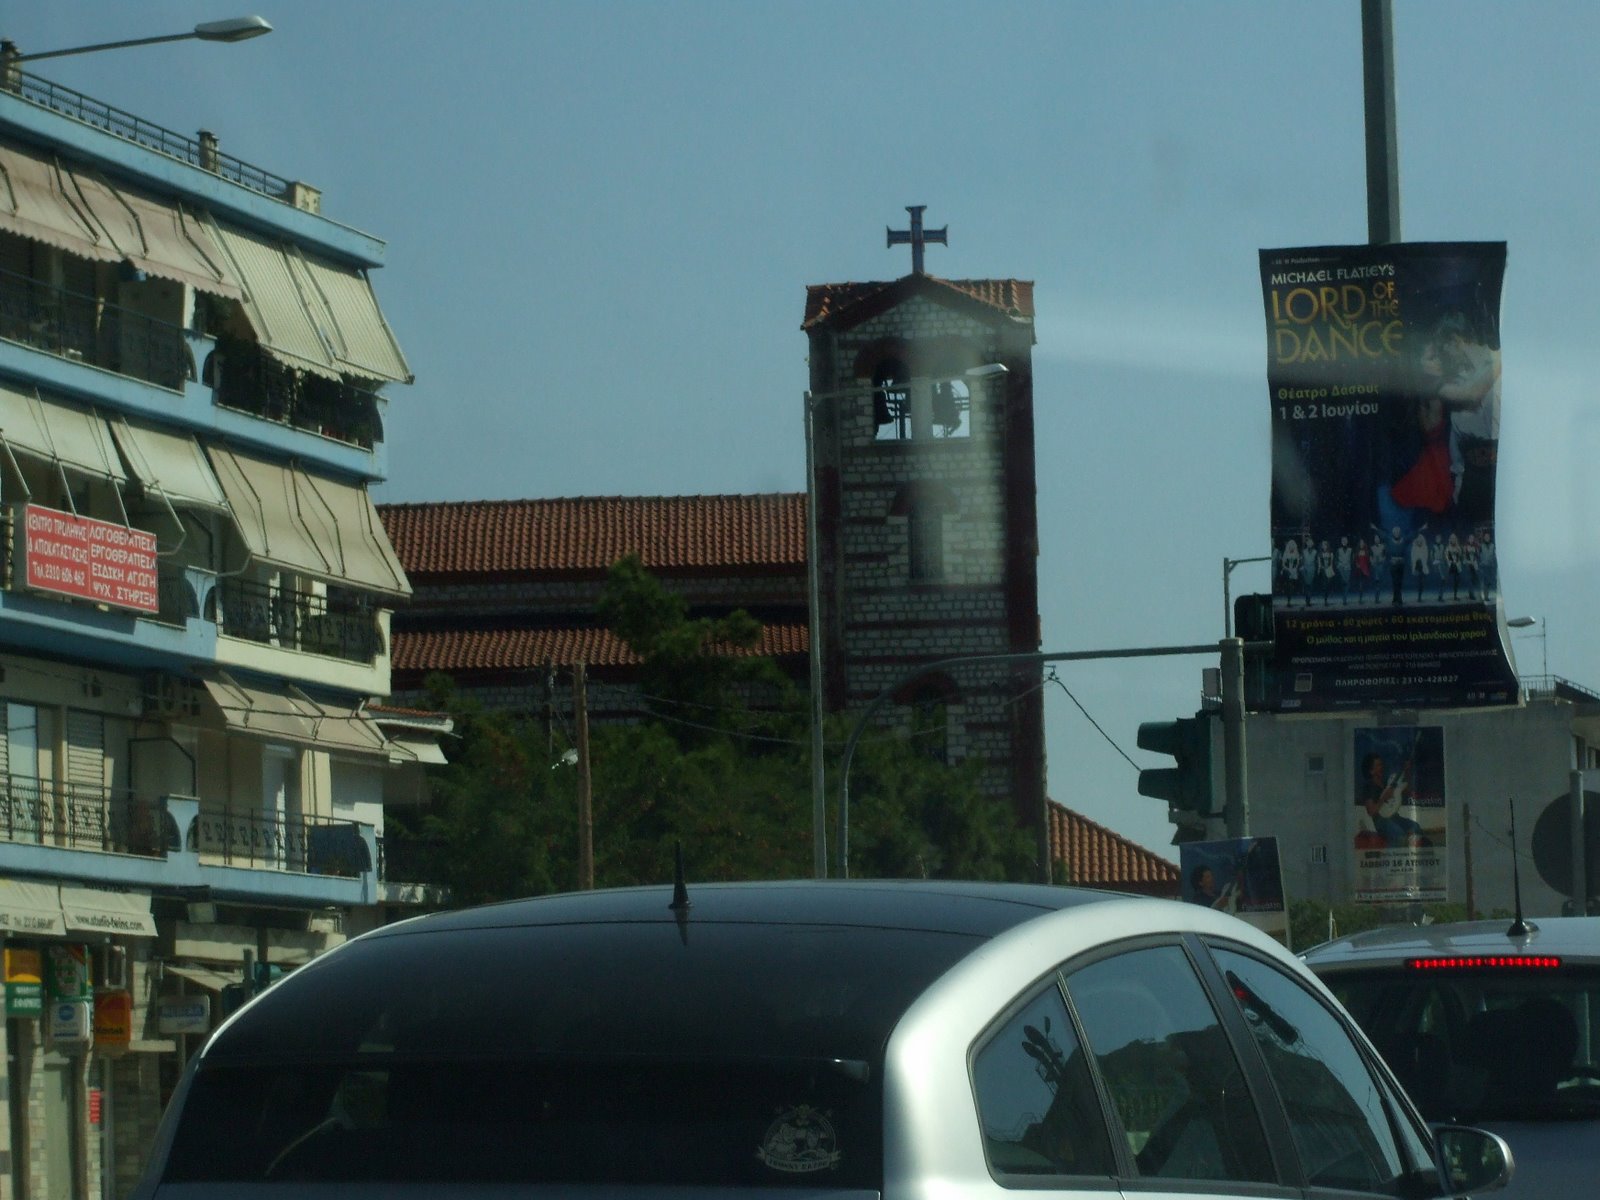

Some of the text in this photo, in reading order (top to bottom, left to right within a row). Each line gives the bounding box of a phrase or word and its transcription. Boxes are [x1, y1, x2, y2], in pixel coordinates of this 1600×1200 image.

[1271, 264, 1395, 285] MICHAEL FLATLEY'S
[1372, 281, 1395, 300] OF
[1272, 284, 1366, 328] LORD
[1369, 299, 1399, 318] THE
[1275, 320, 1404, 365] DANCE
[1278, 387, 1328, 401] Θέατρο
[1279, 400, 1379, 420] 1 & 2 Ιουνίου
[89, 525, 157, 553] ΛΟΓΟΘΕΡΑΠΕΙΑ
[91, 543, 157, 570] ΕΡΓΟΘΕΡΑΠΕΙΑ
[92, 562, 157, 589] ΕΙΔΙΚΗ ΑΓΩΓΗ
[116, 586, 157, 607] ΣΤΗΡΙΞΗ
